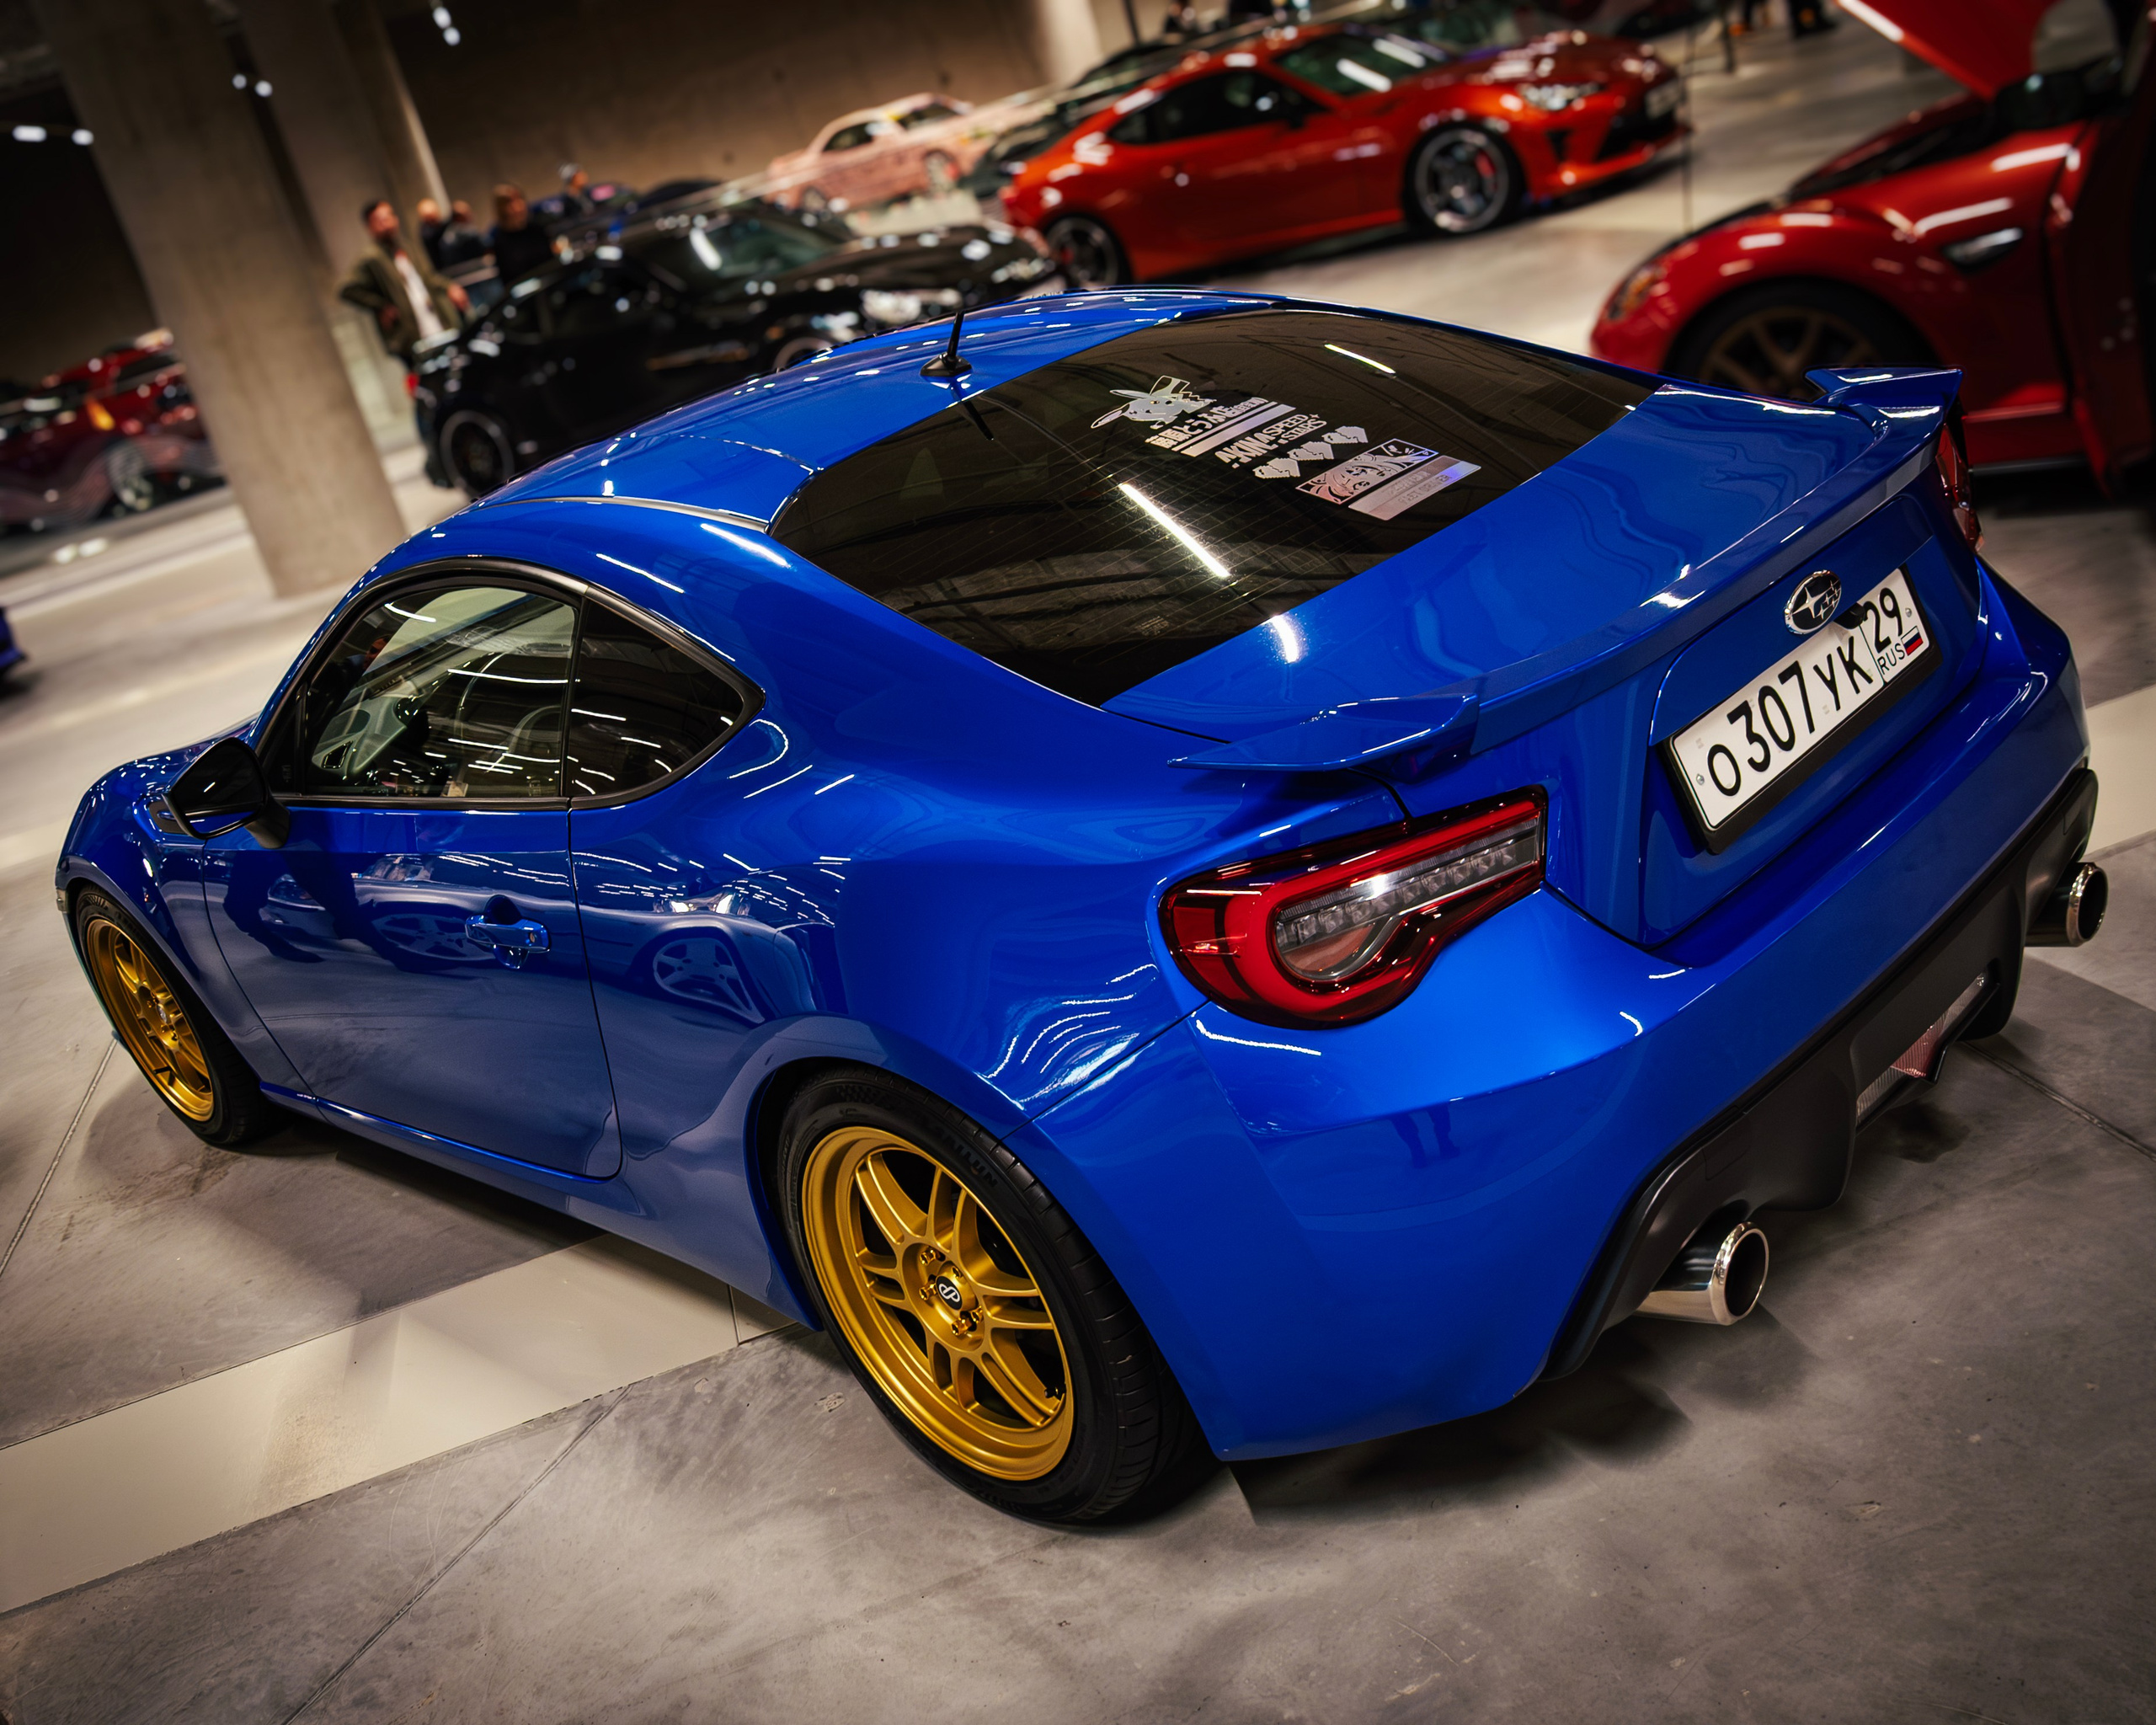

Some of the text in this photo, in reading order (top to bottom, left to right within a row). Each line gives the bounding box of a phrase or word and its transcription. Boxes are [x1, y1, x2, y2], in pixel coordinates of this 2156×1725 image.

[1262, 414, 1309, 436] SPEED
[1280, 419, 1327, 441] STARS
[1863, 587, 1903, 654] 29
[1877, 643, 1906, 676] RUS
